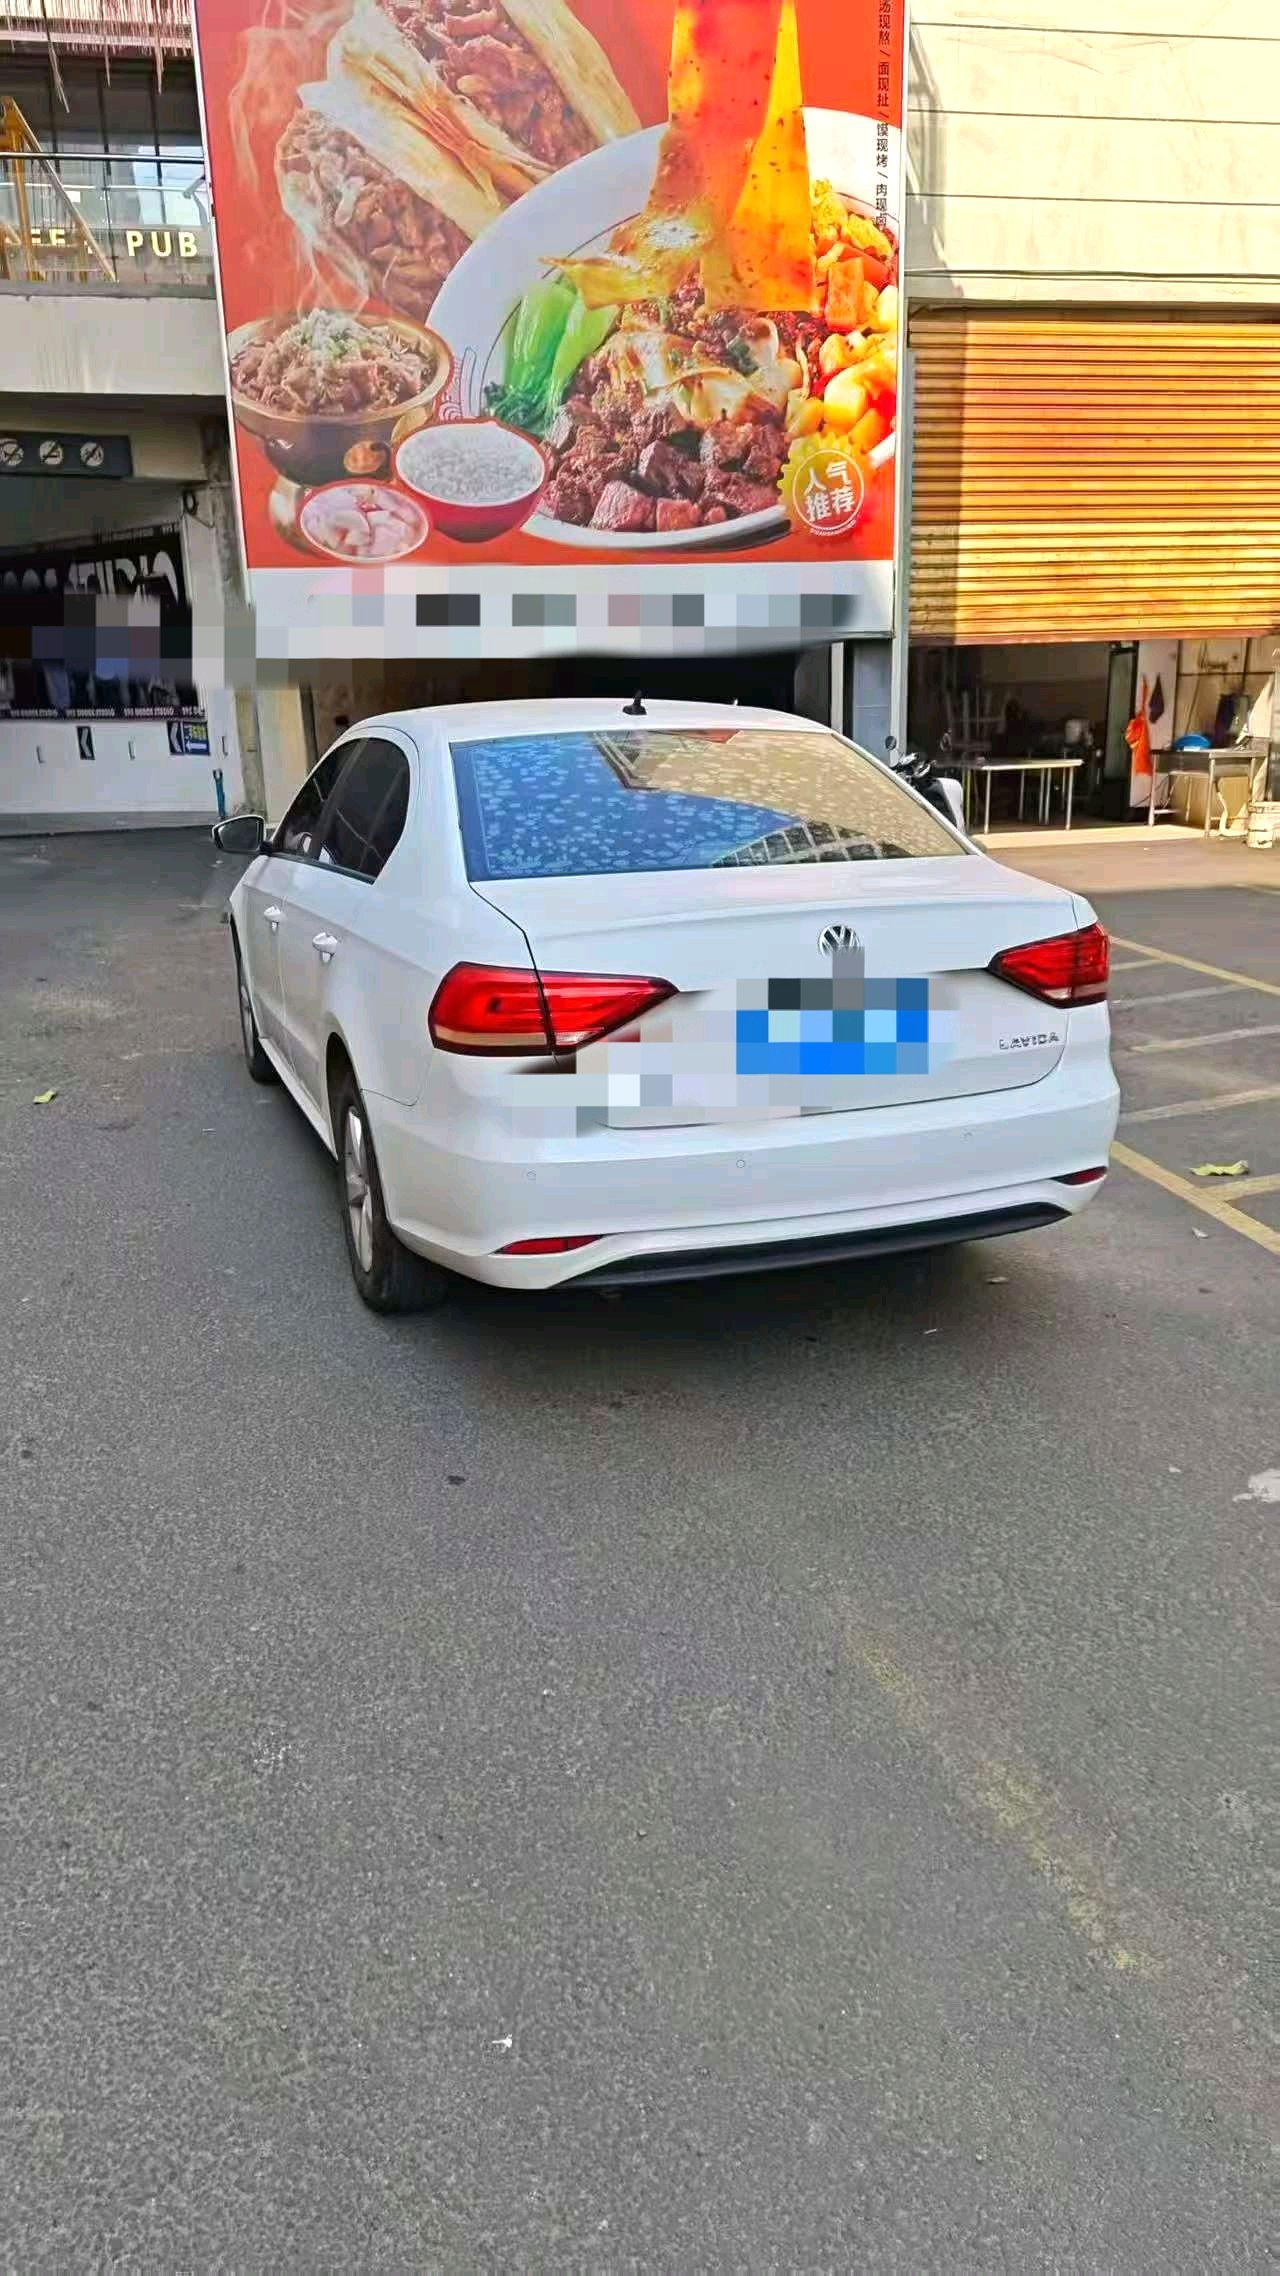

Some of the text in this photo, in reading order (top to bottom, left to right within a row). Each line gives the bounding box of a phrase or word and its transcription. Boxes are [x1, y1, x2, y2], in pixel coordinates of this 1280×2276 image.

[126, 230, 198, 257] PUB
[803, 461, 851, 495] 人气
[805, 484, 856, 521] 推荐
[998, 1032, 1060, 1050] LAVIDA
